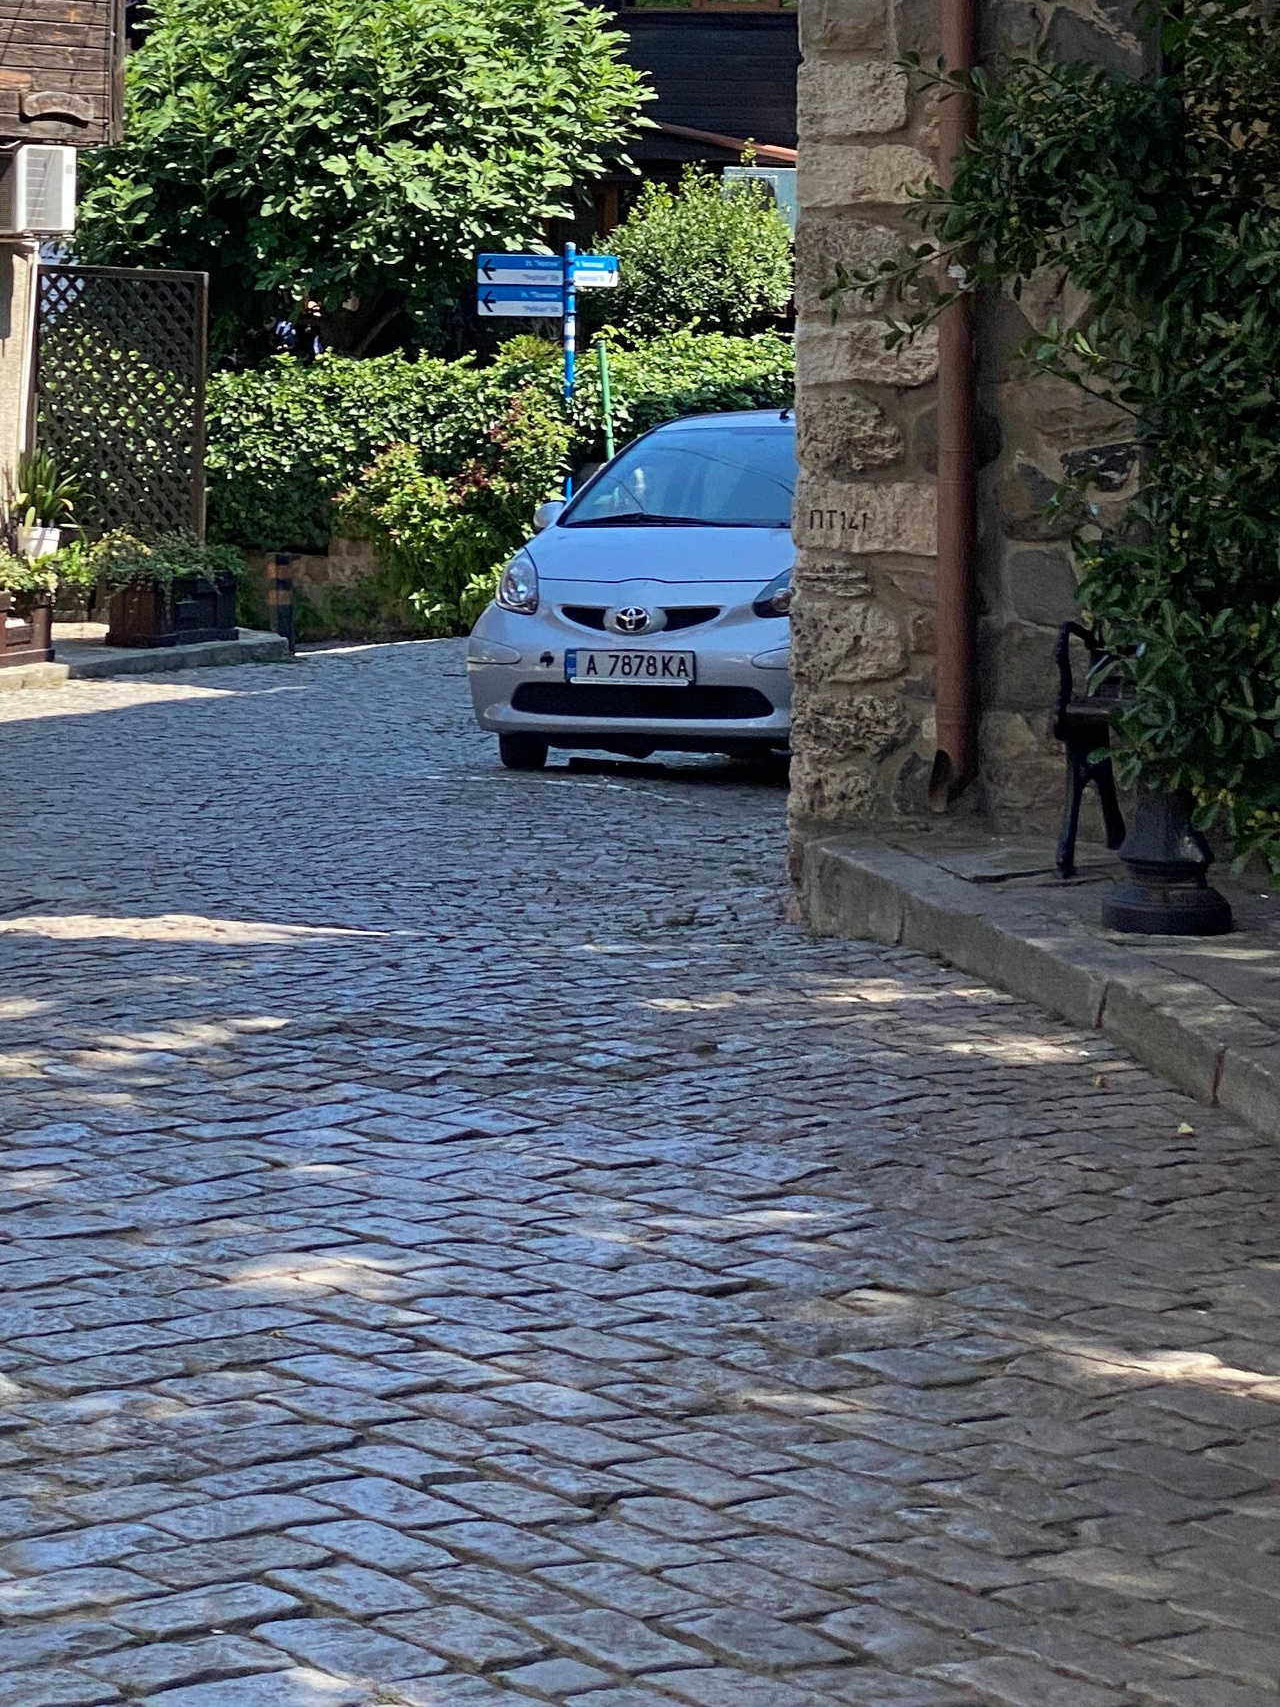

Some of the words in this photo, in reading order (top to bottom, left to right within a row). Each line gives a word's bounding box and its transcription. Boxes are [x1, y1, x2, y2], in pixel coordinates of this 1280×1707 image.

[586, 654, 598, 675] A
[608, 654, 658, 677] 7878
[661, 655, 689, 677] KA
